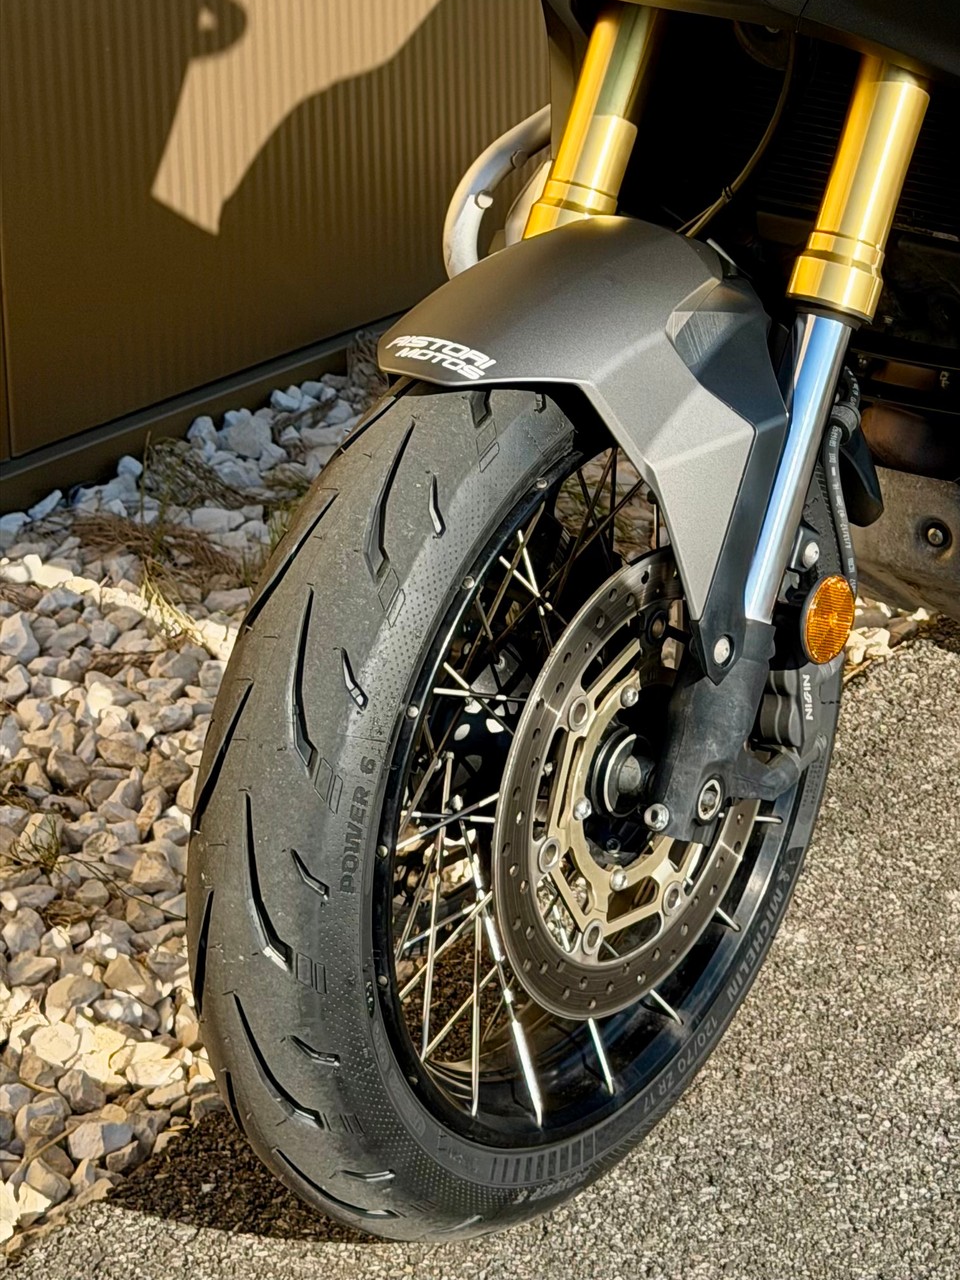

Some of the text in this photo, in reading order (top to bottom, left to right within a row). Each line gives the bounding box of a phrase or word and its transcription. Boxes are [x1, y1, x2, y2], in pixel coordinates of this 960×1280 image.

[394, 347, 486, 380] MOTOS
[802, 674, 814, 721] NISSIN
[339, 756, 377, 894] POWER 6
[727, 888, 784, 1002] MICHELIN
[642, 1014, 718, 1114] 120/70 ZR 17
